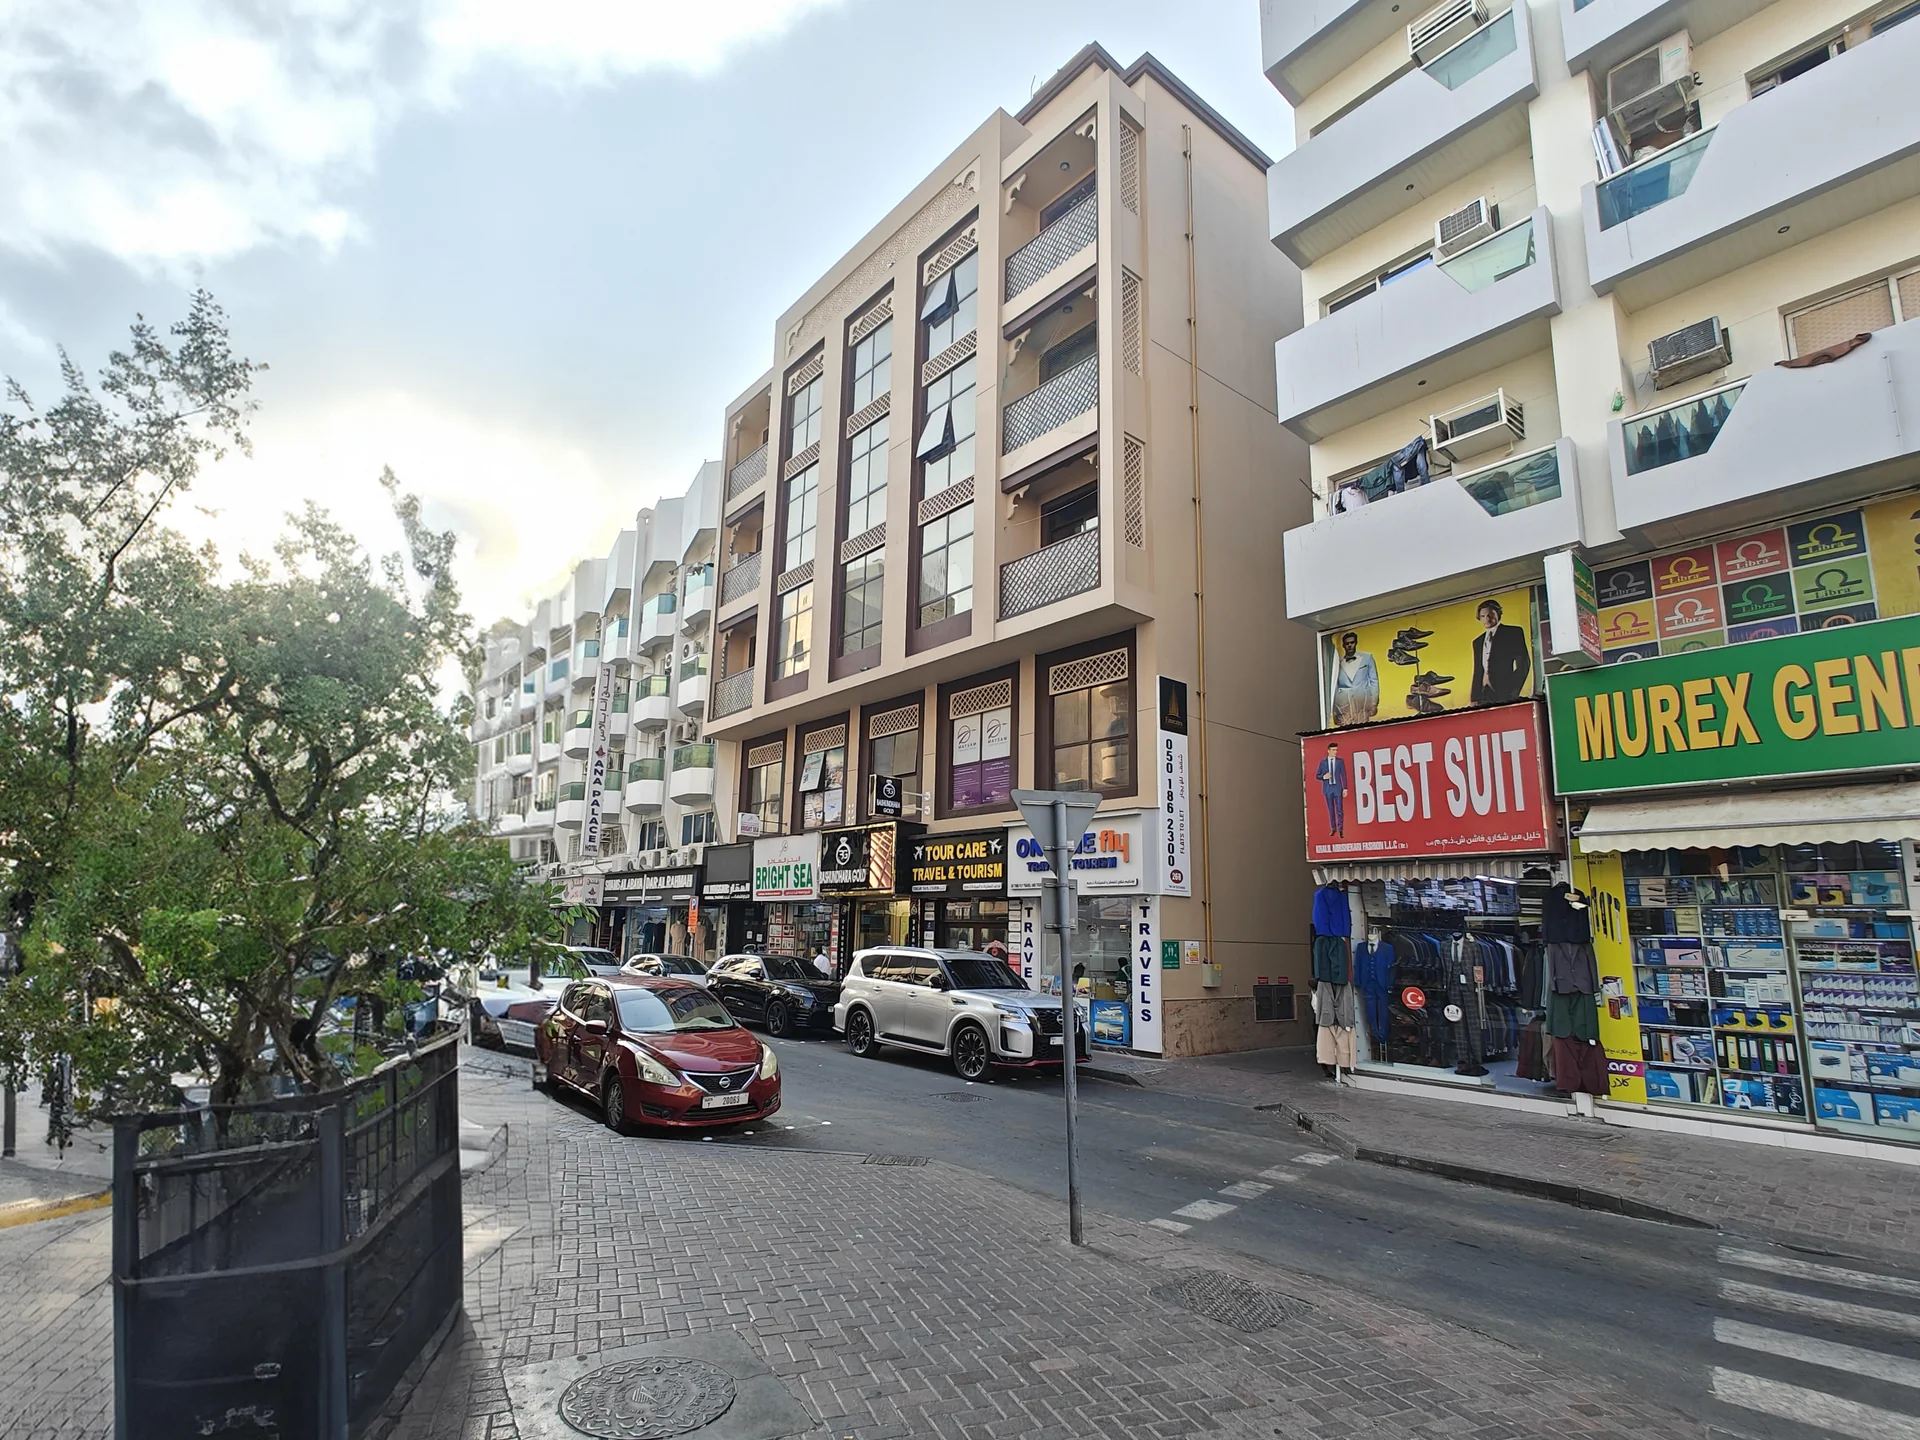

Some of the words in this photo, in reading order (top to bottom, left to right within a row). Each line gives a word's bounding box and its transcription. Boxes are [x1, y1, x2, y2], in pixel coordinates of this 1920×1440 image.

[1808, 541, 1846, 554] Libra
[1735, 557, 1769, 570] Libra
[1669, 573, 1699, 584] Libra
[1609, 586, 1637, 597] Libra
[1815, 587, 1851, 599] Libra
[1741, 600, 1775, 612] Libra
[1674, 613, 1706, 626] Libra
[1613, 627, 1640, 637] Libra
[1574, 672, 1763, 761] MUREX
[1165, 738, 1173, 774] 050
[593, 759, 604, 785] ANA
[1353, 742, 1433, 824] BEST
[1443, 729, 1527, 818] SUIT
[1166, 778, 1174, 814] 186
[588, 790, 601, 843] PALACE
[925, 844, 955, 861] TOUR
[956, 841, 987, 859] CARE
[1099, 830, 1129, 863] fly
[1167, 818, 1175, 867] 2300
[912, 866, 946, 881] TRAVEL
[948, 866, 955, 879] &
[957, 863, 1003, 879] TOURISM
[1071, 857, 1117, 870] TOURISM
[755, 865, 791, 889] BRIGHT
[793, 862, 813, 888] SEA
[819, 869, 851, 883] BASHUNDHARA
[852, 869, 866, 882] GOLD
[1139, 906, 1151, 1022] TRAVELS
